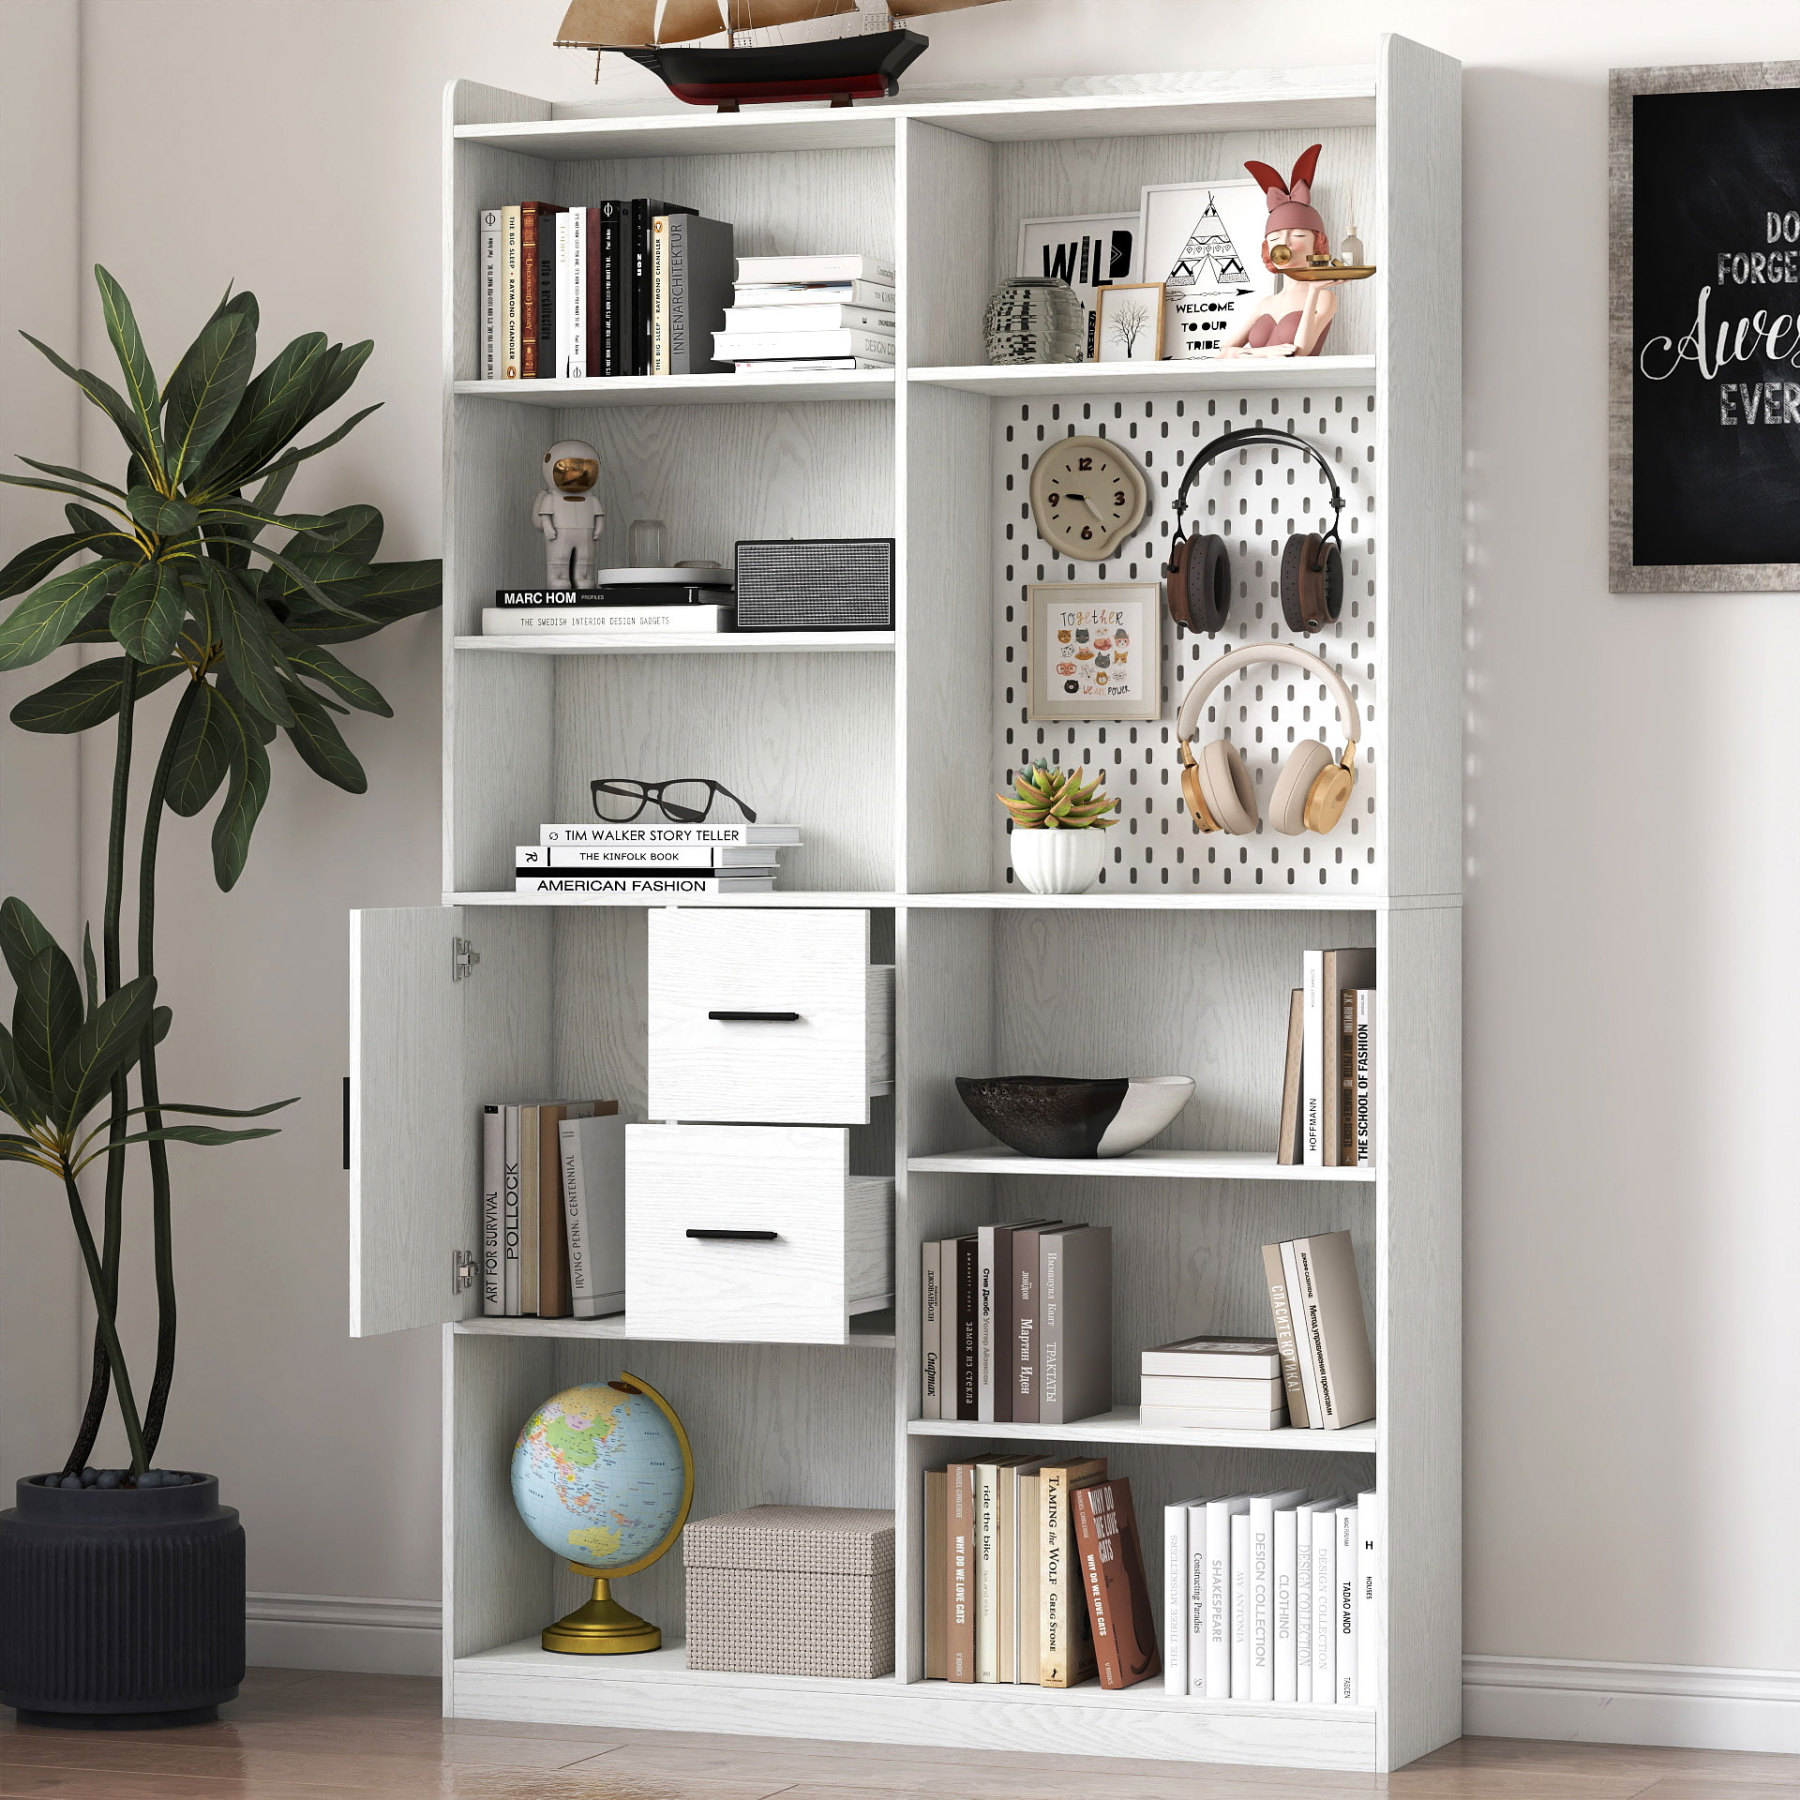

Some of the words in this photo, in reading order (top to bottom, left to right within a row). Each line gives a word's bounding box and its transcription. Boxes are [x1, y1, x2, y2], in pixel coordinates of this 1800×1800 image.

[1042, 230, 1133, 287] WILD
[1717, 252, 1800, 285] FORGE
[671, 224, 684, 355] INNENARCHITEKTUR
[1176, 301, 1235, 313] WELCOME
[1181, 322, 1197, 332] TO
[1201, 321, 1227, 331] OUR
[1186, 340, 1220, 350] TRIBE
[1079, 457, 1092, 471] 12
[1048, 493, 1059, 507] 9
[1114, 491, 1125, 506] 3
[1081, 525, 1092, 540] 6
[504, 592, 542, 605] MARC
[545, 592, 576, 604] HOM
[520, 618, 533, 627] THE
[537, 618, 567, 627] SWEDISH
[572, 617, 605, 626] INTERIOR
[609, 617, 636, 625] DESIGN
[565, 831, 587, 841] TIM
[592, 831, 645, 841] WALKER
[650, 831, 692, 841] STORY
[696, 831, 739, 841] TELLER
[579, 852, 600, 861] THE
[603, 852, 646, 861] KINFOLK
[650, 852, 679, 861] BOOK
[537, 881, 626, 892] AMERICAN
[632, 881, 706, 892] FASHION
[1357, 1024, 1368, 1072] FASHION
[1357, 1074, 1368, 1089] OF
[1309, 1098, 1317, 1151] HOFFMANN
[1357, 1091, 1368, 1137] SCHOOL
[1357, 1139, 1368, 1161] THE
[565, 1154, 579, 1217] CENTENNIAL
[486, 1192, 498, 1247] SURVIVAL
[506, 1162, 519, 1260] POLLOCK
[486, 1250, 498, 1276] FOR
[573, 1251, 584, 1289] IRVING
[982, 1268, 990, 1288] Стив
[486, 1280, 498, 1304] ART
[982, 1289, 990, 1316] Джобс
[1047, 1303, 1057, 1326] Кант
[1272, 1284, 1291, 1337] СПАСИТЕ
[1309, 1304, 1318, 1328] Метод
[965, 1321, 974, 1351] замок
[1019, 1318, 1033, 1361] Мартин
[925, 1352, 938, 1397] Спартак
[965, 1356, 973, 1367] из
[1046, 1342, 1057, 1402] ТРАКТАТЫ
[1281, 1341, 1300, 1393] КОТИКА!
[965, 1371, 974, 1404] стекла
[1019, 1366, 1032, 1394] Иден
[983, 1485, 991, 1509] ride
[1048, 1475, 1060, 1528] TAMING
[983, 1512, 991, 1532] the
[955, 1536, 965, 1553] WHY
[983, 1535, 991, 1561] bike
[1049, 1532, 1057, 1546] the
[955, 1556, 965, 1566] DO
[1049, 1548, 1059, 1585] WOLF
[1086, 1554, 1095, 1571] WHY
[1256, 1532, 1266, 1581] DESIGN
[1299, 1544, 1312, 1589] DESIGN
[955, 1568, 965, 1581] WE
[1090, 1573, 1097, 1583] DO
[1170, 1535, 1178, 1605] MUSKETEERS
[1192, 1552, 1202, 1601] Constructing
[1236, 1571, 1244, 1586] MY
[1318, 1550, 1328, 1592] DESIGN
[955, 1583, 965, 1602] LOVE
[1092, 1585, 1100, 1597] WE
[1212, 1560, 1222, 1643] SHAKESPEARE
[1342, 1581, 1351, 1610] TADAO
[955, 1604, 965, 1624] CATS
[1049, 1593, 1057, 1619] GREG
[1094, 1598, 1103, 1616] LOVE
[1236, 1594, 1244, 1643] ANTONIA
[1279, 1574, 1290, 1640] CLOTHING
[1096, 1617, 1106, 1636] CATS
[1170, 1609, 1178, 1644] THREE
[1256, 1585, 1266, 1668] COLLECTION
[1299, 1592, 1312, 1667] COLLECTION
[1318, 1596, 1328, 1670] COLLECTION
[1342, 1611, 1351, 1634] ANDO
[1049, 1622, 1058, 1652] STONE
